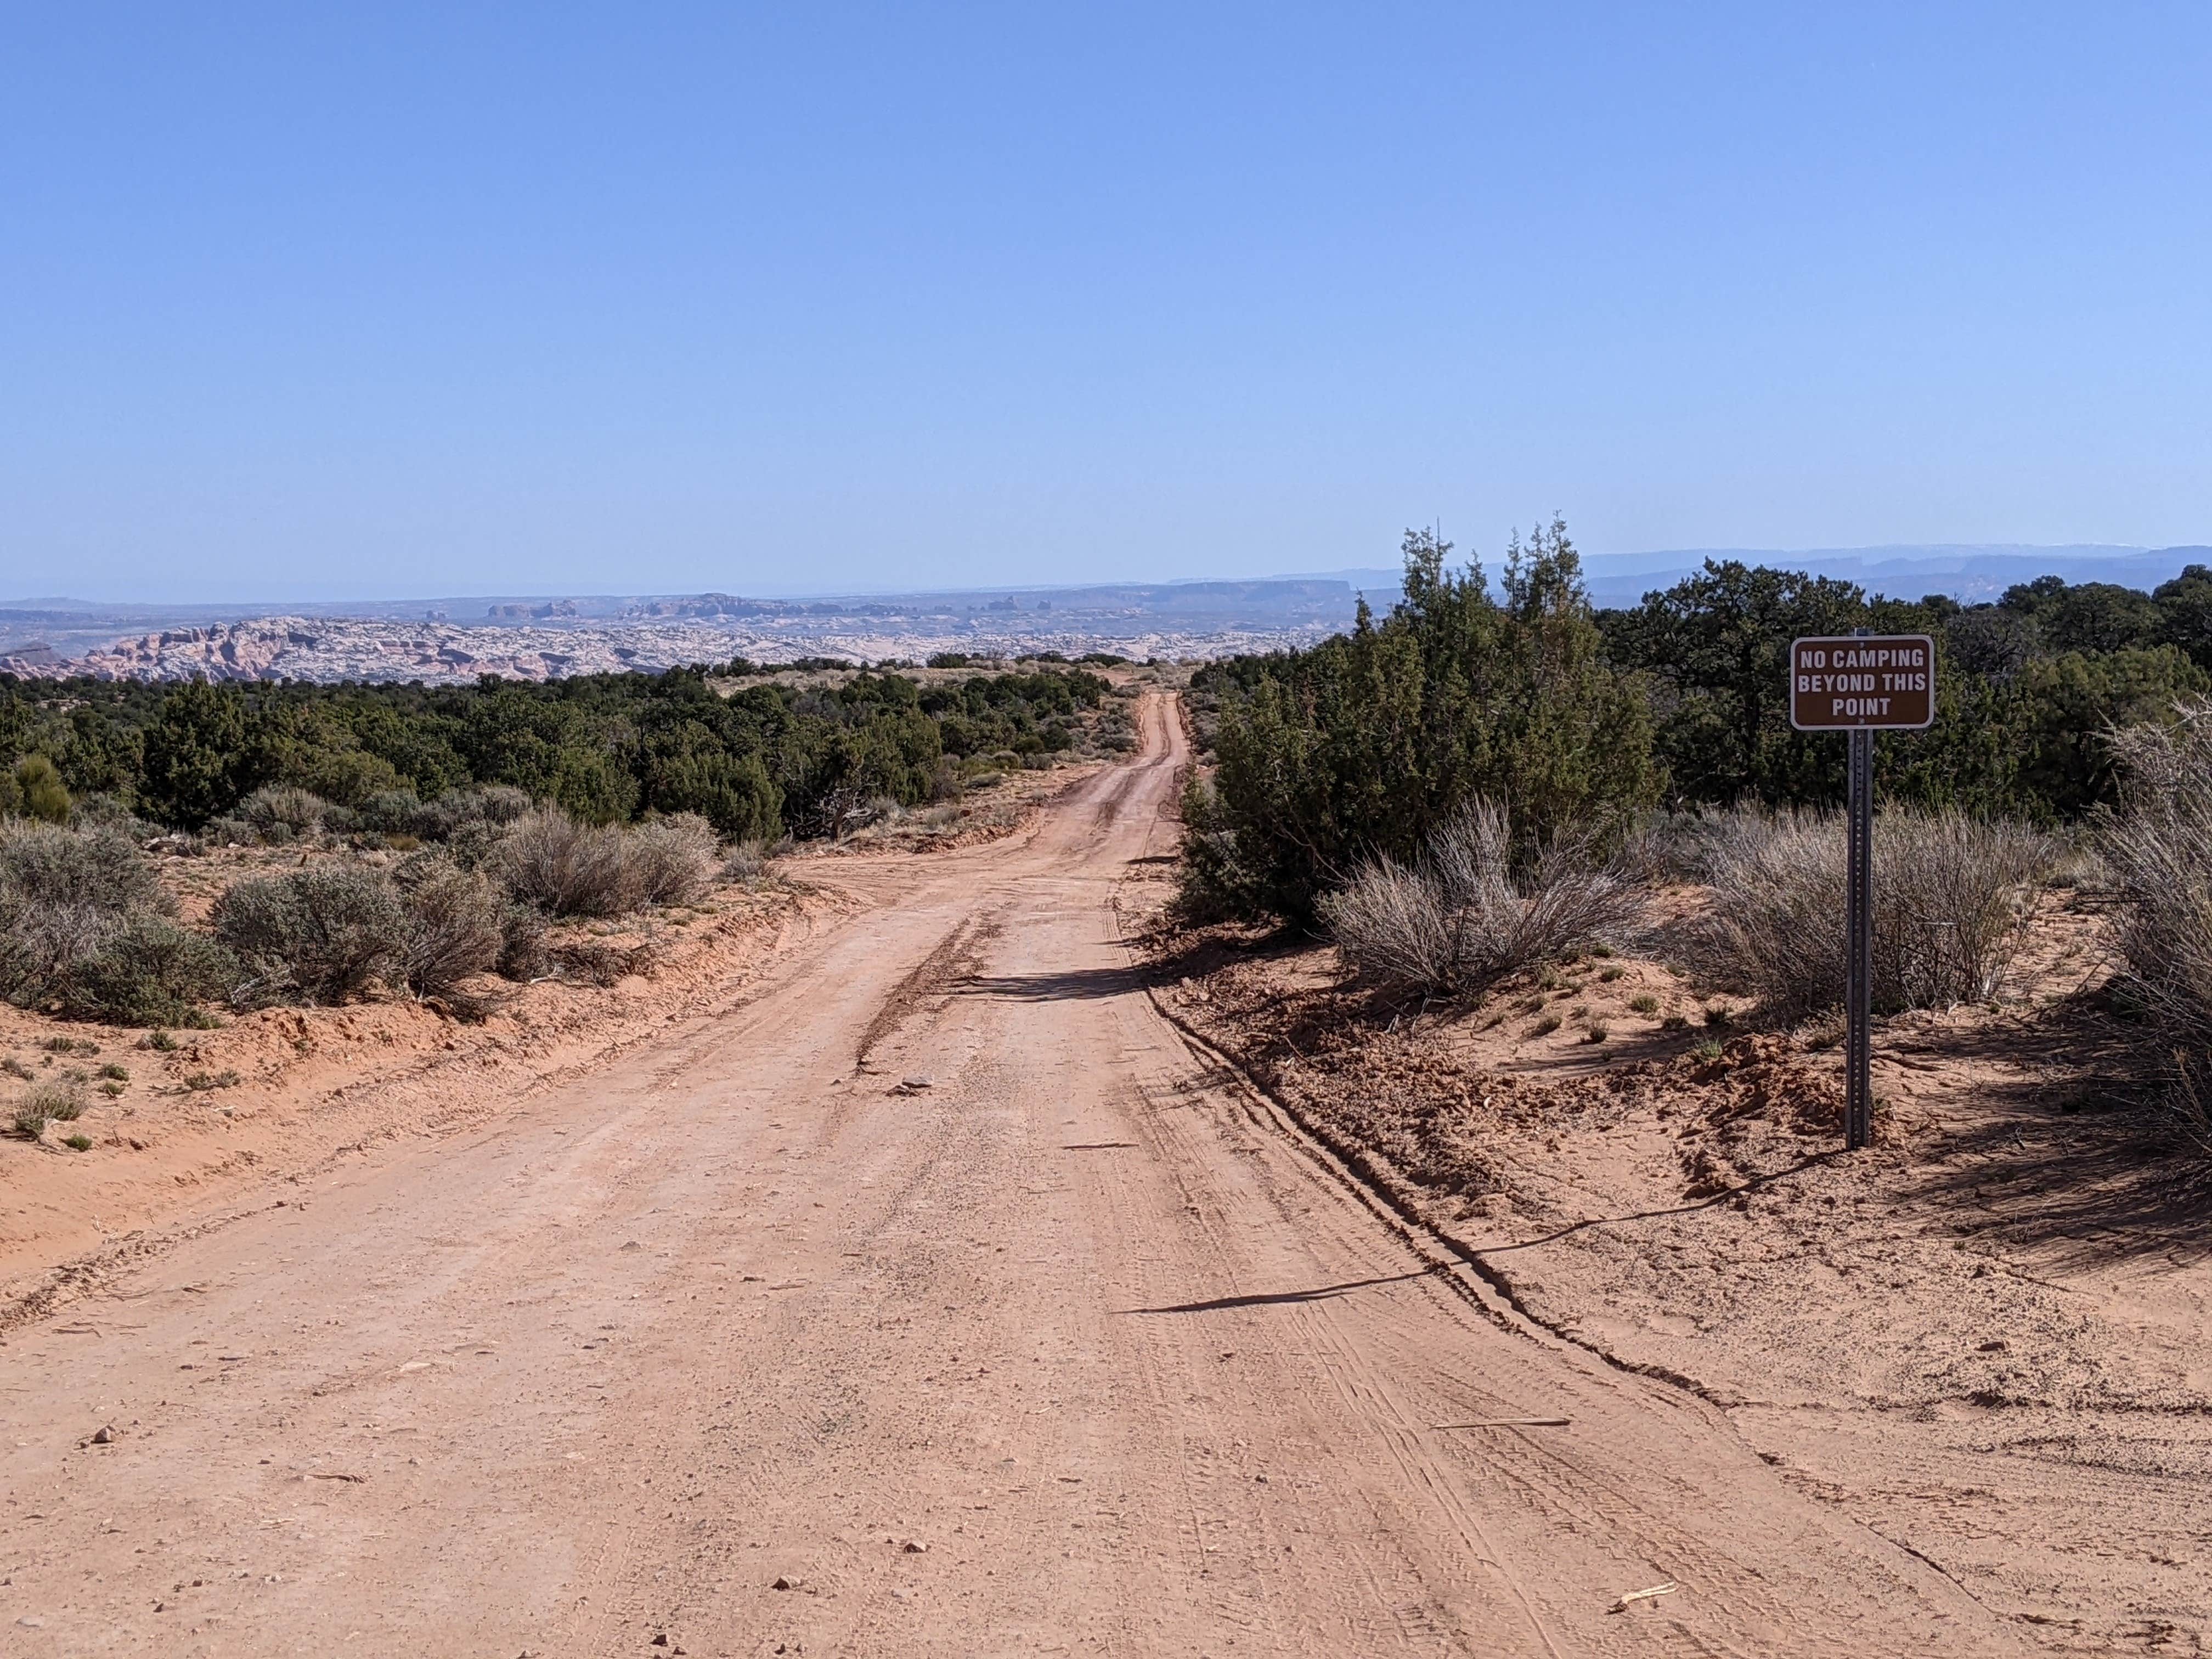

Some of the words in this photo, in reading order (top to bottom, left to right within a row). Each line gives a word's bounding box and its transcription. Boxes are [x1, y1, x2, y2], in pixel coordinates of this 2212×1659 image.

[1801, 650, 1826, 668] NO
[1832, 649, 1923, 668] CAMPING
[1798, 674, 1875, 692] BEYOND
[1882, 673, 1926, 691] THIS
[1832, 698, 1891, 716] POINT
